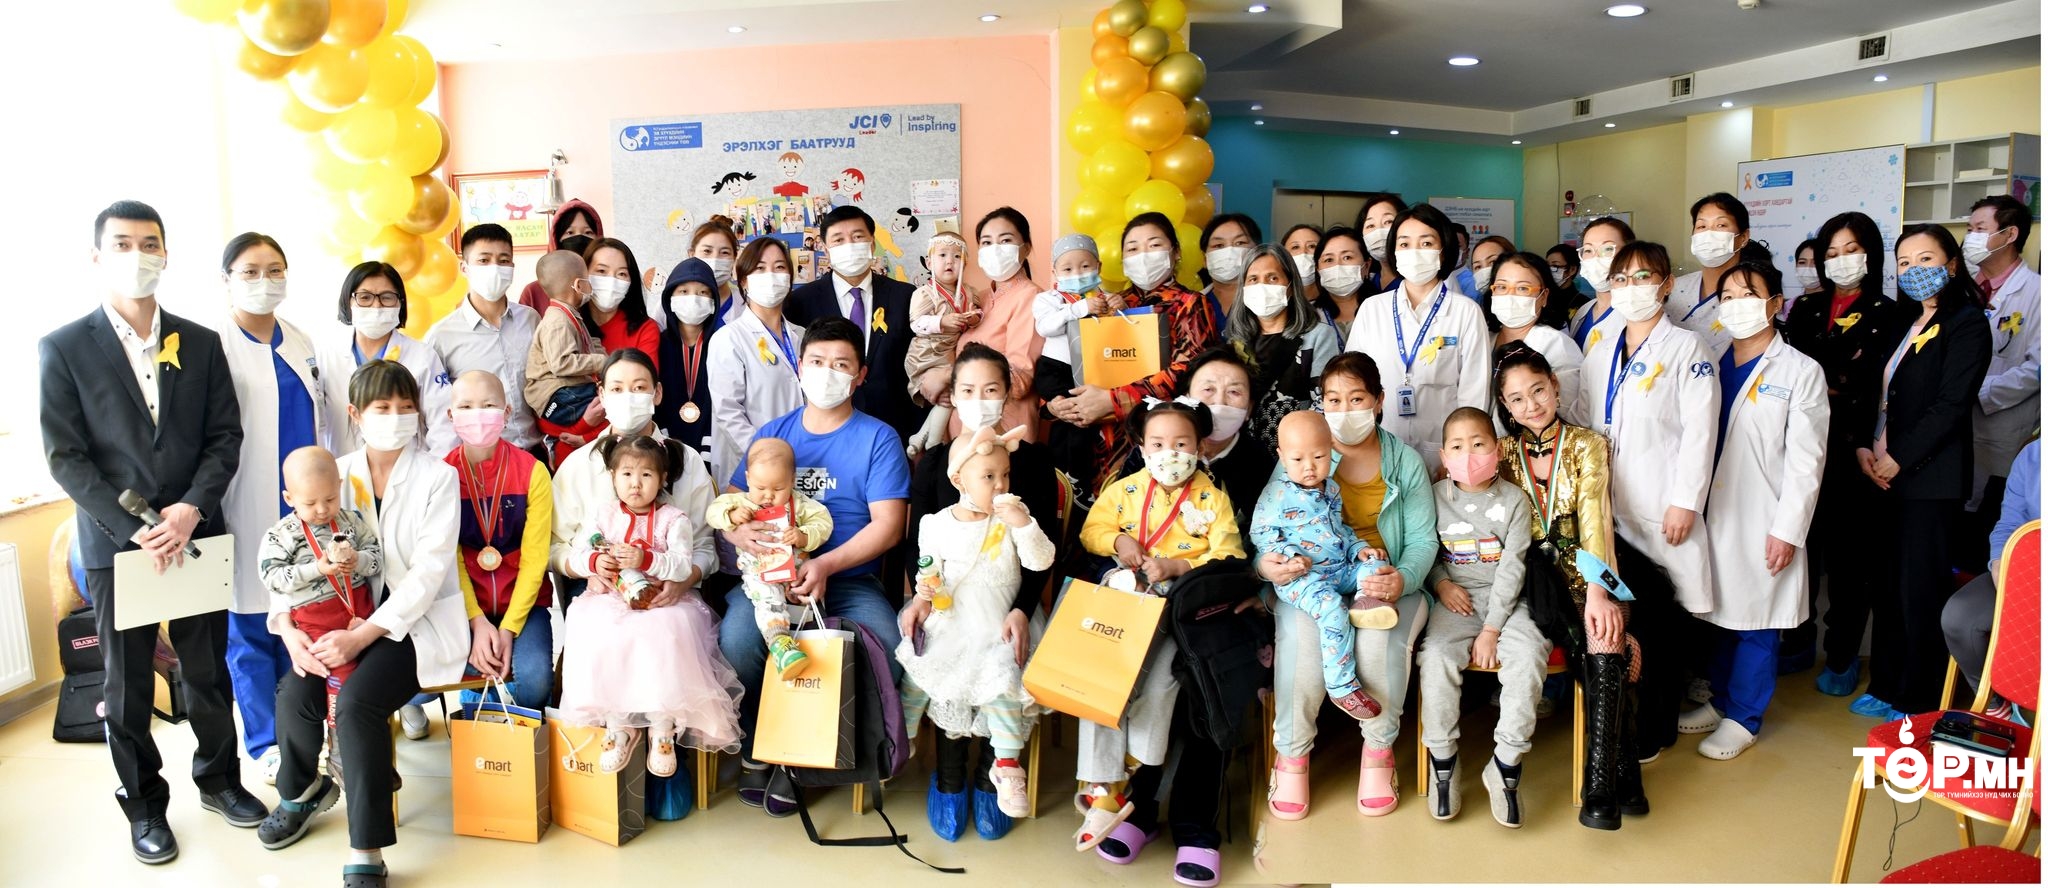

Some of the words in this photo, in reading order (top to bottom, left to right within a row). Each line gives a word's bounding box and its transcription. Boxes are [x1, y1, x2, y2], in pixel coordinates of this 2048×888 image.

[849, 114, 878, 129] JCI
[926, 114, 935, 123] by
[908, 120, 957, 133] Inspiring
[722, 140, 783, 152] ЭРЭЛХЭГ
[790, 137, 856, 150] БААТРУУД
[1103, 347, 1136, 359] emart
[795, 477, 837, 489] ESIGN
[1081, 617, 1125, 640] emart
[475, 756, 512, 772] emart
